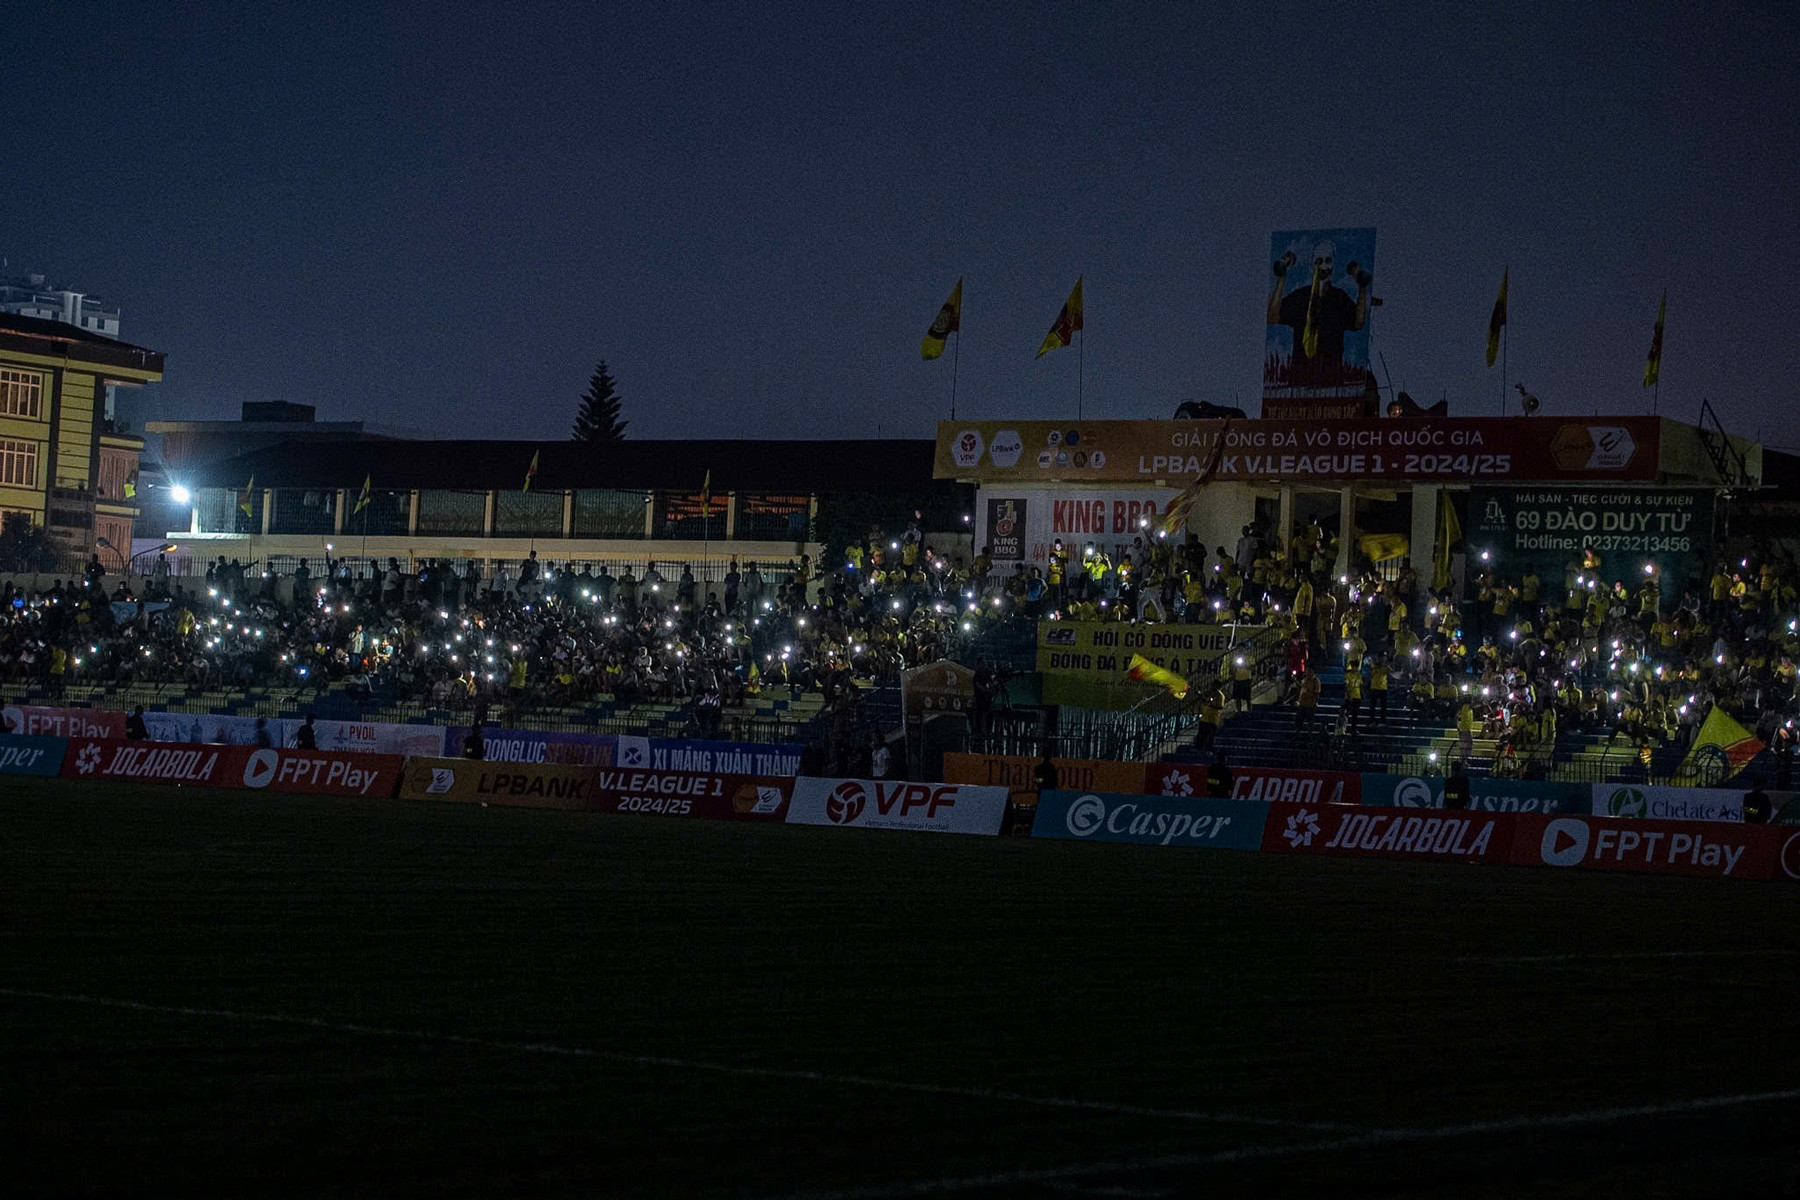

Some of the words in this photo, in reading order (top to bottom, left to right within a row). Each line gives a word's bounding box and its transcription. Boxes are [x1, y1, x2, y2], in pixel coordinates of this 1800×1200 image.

[1171, 427, 1207, 446] GIẢI
[1272, 428, 1298, 446] ĐÁ
[1304, 428, 1331, 446] VÔ
[1337, 431, 1382, 449] ĐỊCH
[1389, 425, 1444, 446] QUỐC
[1450, 431, 1484, 445] GIA
[1139, 455, 1238, 473] LPBAK
[1245, 455, 1366, 473] V.LEAGUE
[1371, 455, 1384, 473] 1
[1404, 455, 1511, 475] 2024/25
[1634, 496, 1642, 504] &
[1052, 500, 1105, 533] KING
[1515, 511, 1540, 530] 69
[1546, 506, 1596, 531] ĐÀO
[1603, 512, 1651, 531] DUY
[1656, 508, 1691, 532] TỪ
[993, 537, 1018, 546] KING
[1515, 534, 1577, 550] Hotline:
[1583, 536, 1690, 551] 02373213456
[1051, 650, 1092, 669] BÓNG
[1097, 653, 1116, 670] ĐÁ
[28, 715, 65, 736] FPT
[349, 726, 376, 740] PVOIL
[0, 746, 45, 769] per
[102, 746, 219, 781] JOGARBOLA
[654, 748, 667, 770] XI
[671, 746, 711, 772] MĂNG
[715, 748, 752, 774] XUÂN
[755, 750, 801, 776] THÀNH
[278, 758, 326, 785] FPT
[326, 761, 379, 795] Play
[477, 773, 587, 798] LPBANK
[599, 772, 708, 795] V.LEAGUE
[711, 778, 723, 796] 1
[984, 759, 1094, 791] Thaioup
[617, 796, 692, 815] 2024/25
[876, 782, 958, 818] VPF
[1652, 801, 1716, 820] Chelate
[1718, 805, 1744, 821] Asi
[1107, 804, 1231, 845] Casper
[1324, 813, 1496, 856] JOGARBOLA
[1594, 829, 1664, 862] FPT
[1668, 833, 1745, 875] Play
